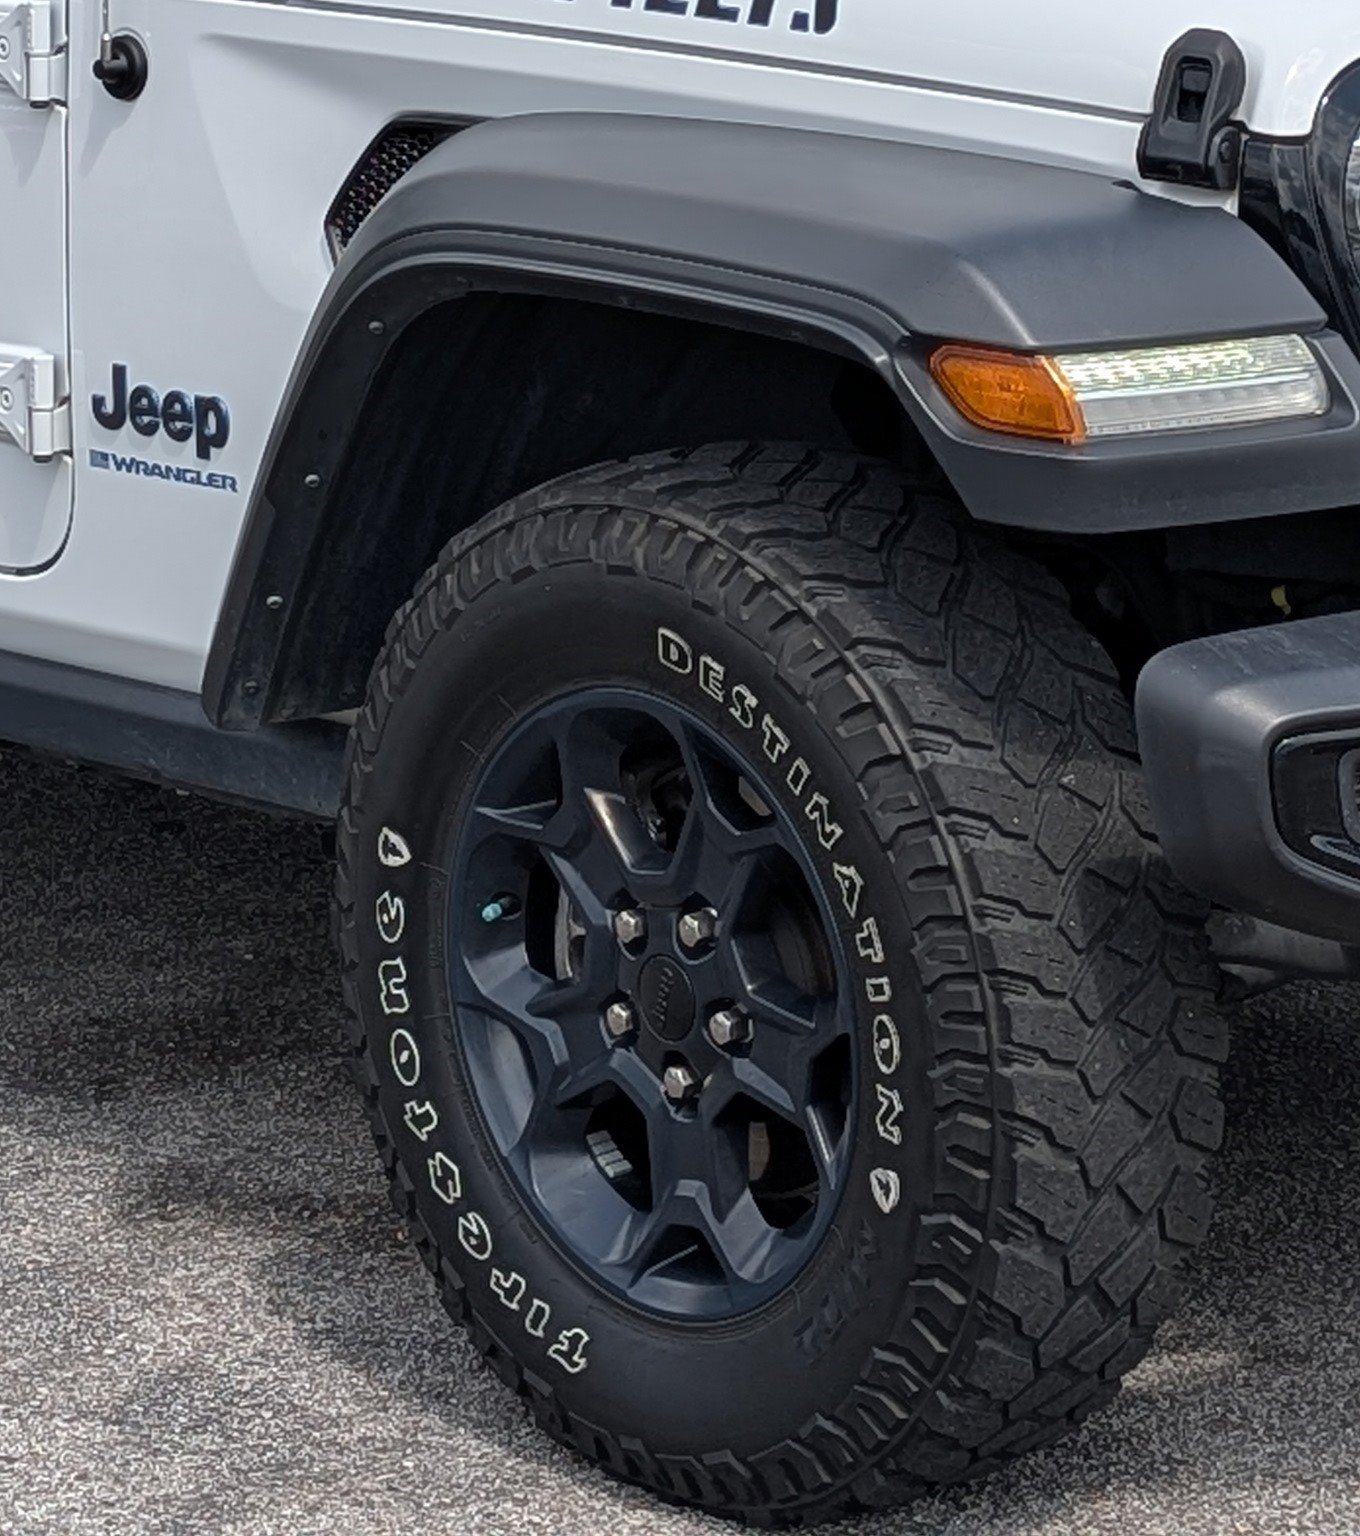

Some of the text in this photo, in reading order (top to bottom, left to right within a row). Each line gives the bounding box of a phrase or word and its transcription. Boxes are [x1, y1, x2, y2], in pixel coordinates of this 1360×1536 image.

[92, 363, 230, 461] Jeep
[110, 452, 238, 493] WRANGLER
[658, 627, 902, 1146] DESTINATION
[376, 890, 592, 1375] Firestone
